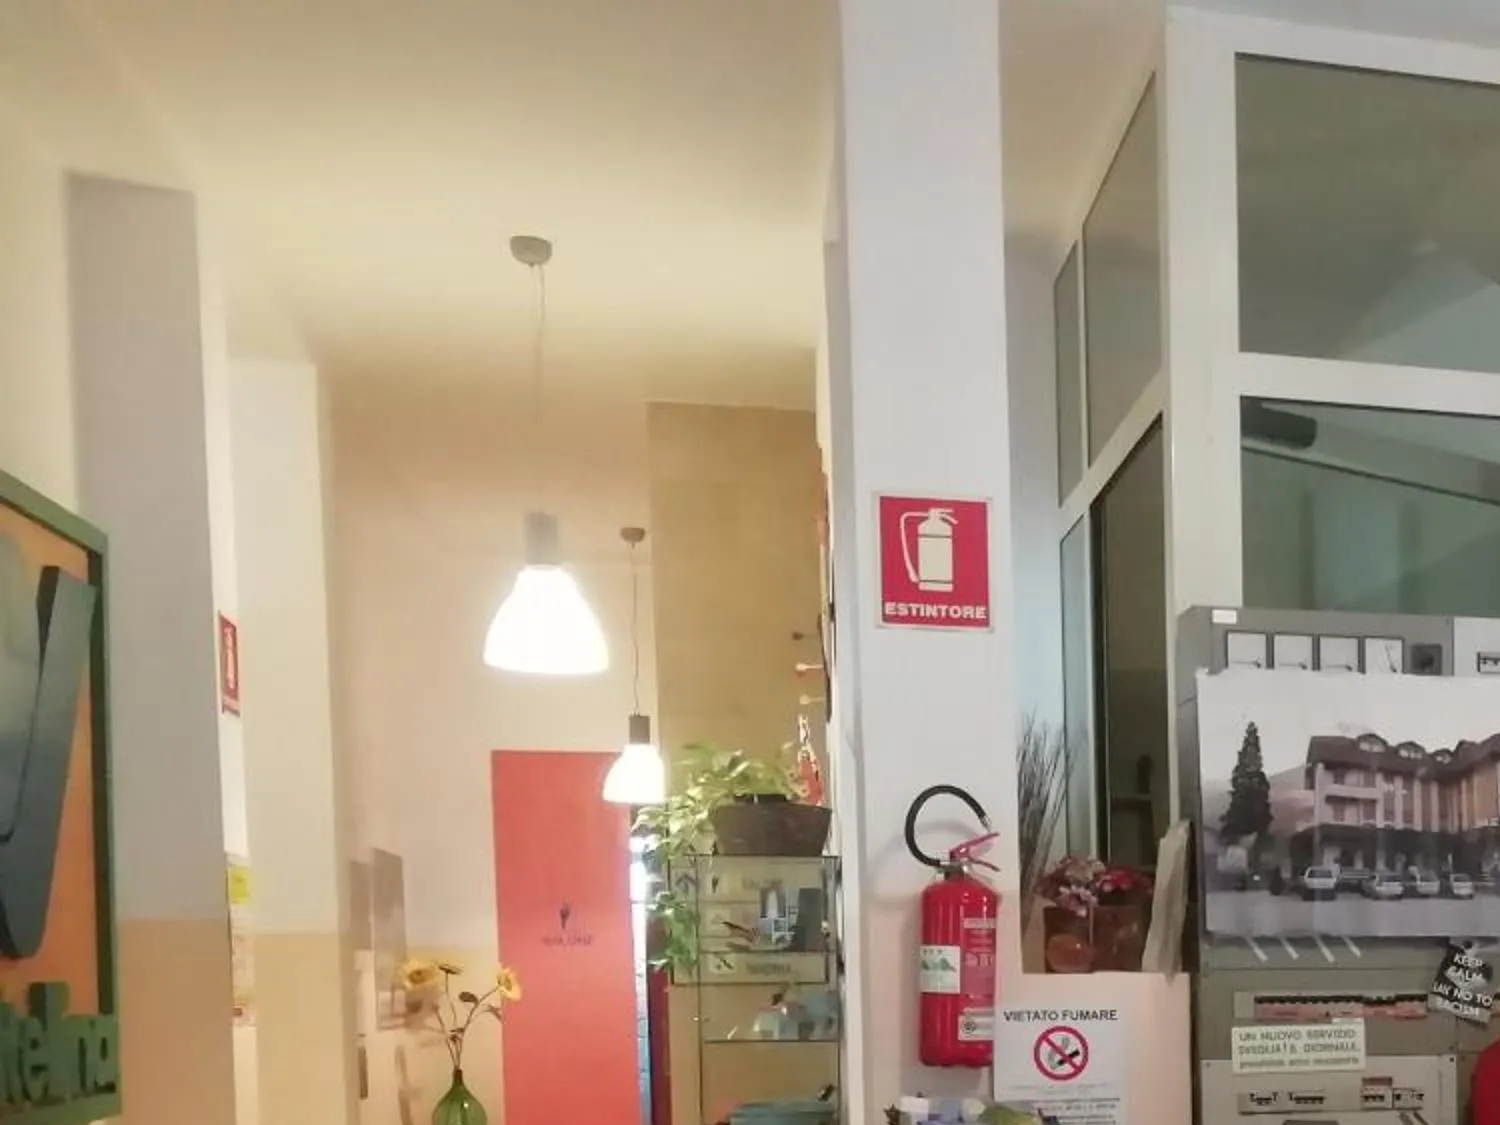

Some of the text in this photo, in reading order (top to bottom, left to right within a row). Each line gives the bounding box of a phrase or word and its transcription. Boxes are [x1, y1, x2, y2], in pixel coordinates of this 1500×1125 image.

[884, 602, 987, 619] ESTINTORE
[1453, 952, 1483, 969] KEEP
[1453, 988, 1474, 1002] NO
[1476, 993, 1493, 1008] TO
[1003, 1009, 1119, 1022] VIETATO FUMARE
